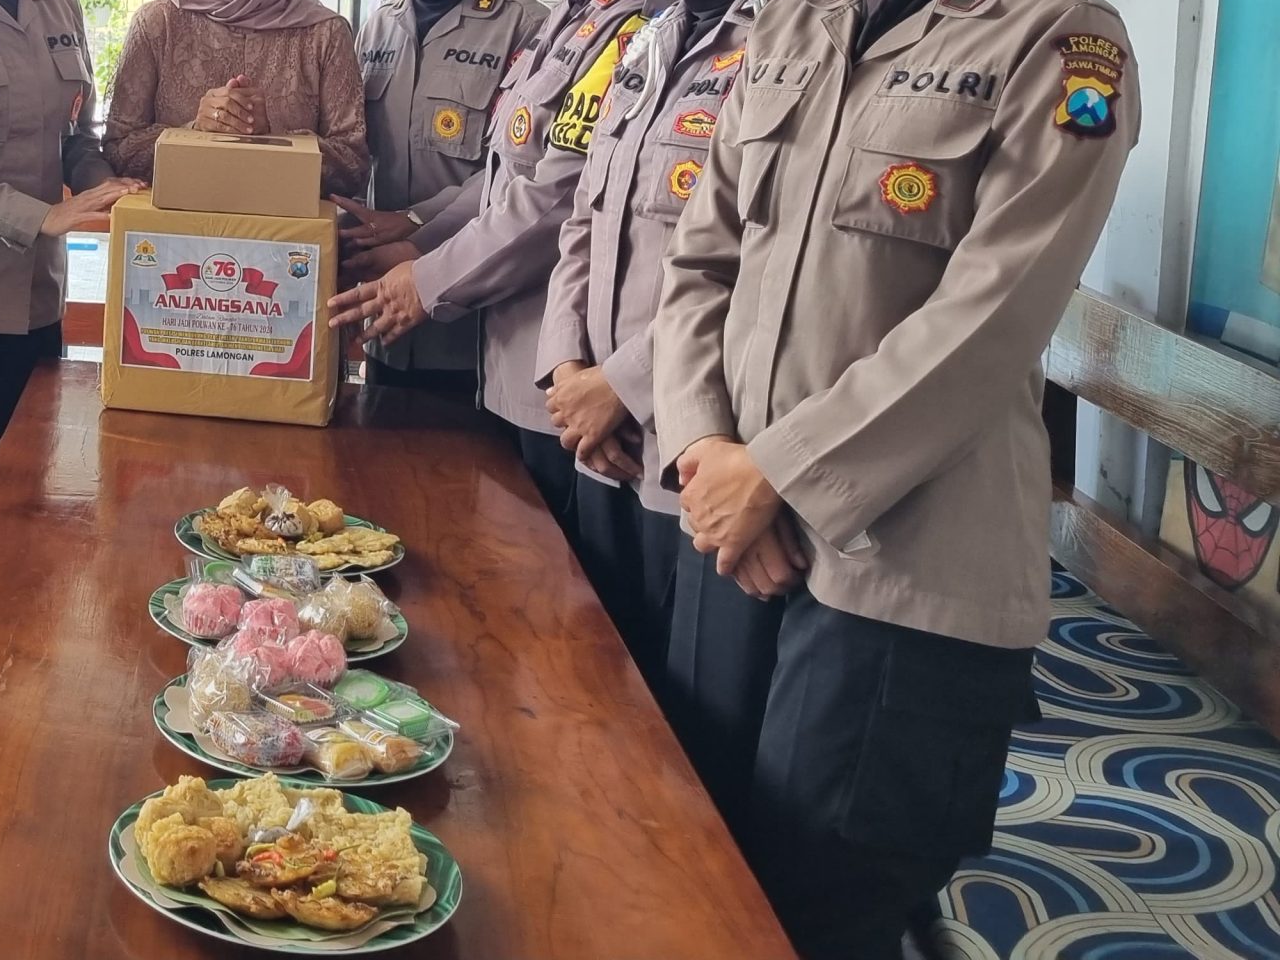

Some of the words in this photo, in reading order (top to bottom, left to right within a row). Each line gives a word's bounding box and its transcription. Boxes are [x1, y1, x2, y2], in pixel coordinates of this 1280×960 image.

[47, 34, 81, 49] POL
[1069, 36, 1119, 55] POLRES
[443, 48, 500, 70] POLRI
[1062, 44, 1121, 64] LAMONGAN
[1066, 61, 1093, 70] JAWA
[1095, 63, 1118, 80] TIMUR
[887, 70, 996, 101] POLRI
[561, 92, 601, 123] PAD
[214, 261, 236, 277] 76
[155, 294, 283, 316] ANJANGSANA
[162, 318, 176, 327] HARI
[177, 319, 190, 328] JADI
[192, 320, 216, 330] POLWAN
[217, 322, 225, 331] KE
[238, 323, 258, 333] TAHUN
[176, 348, 205, 357] POLRES
[206, 350, 254, 362] LAMONGAN
